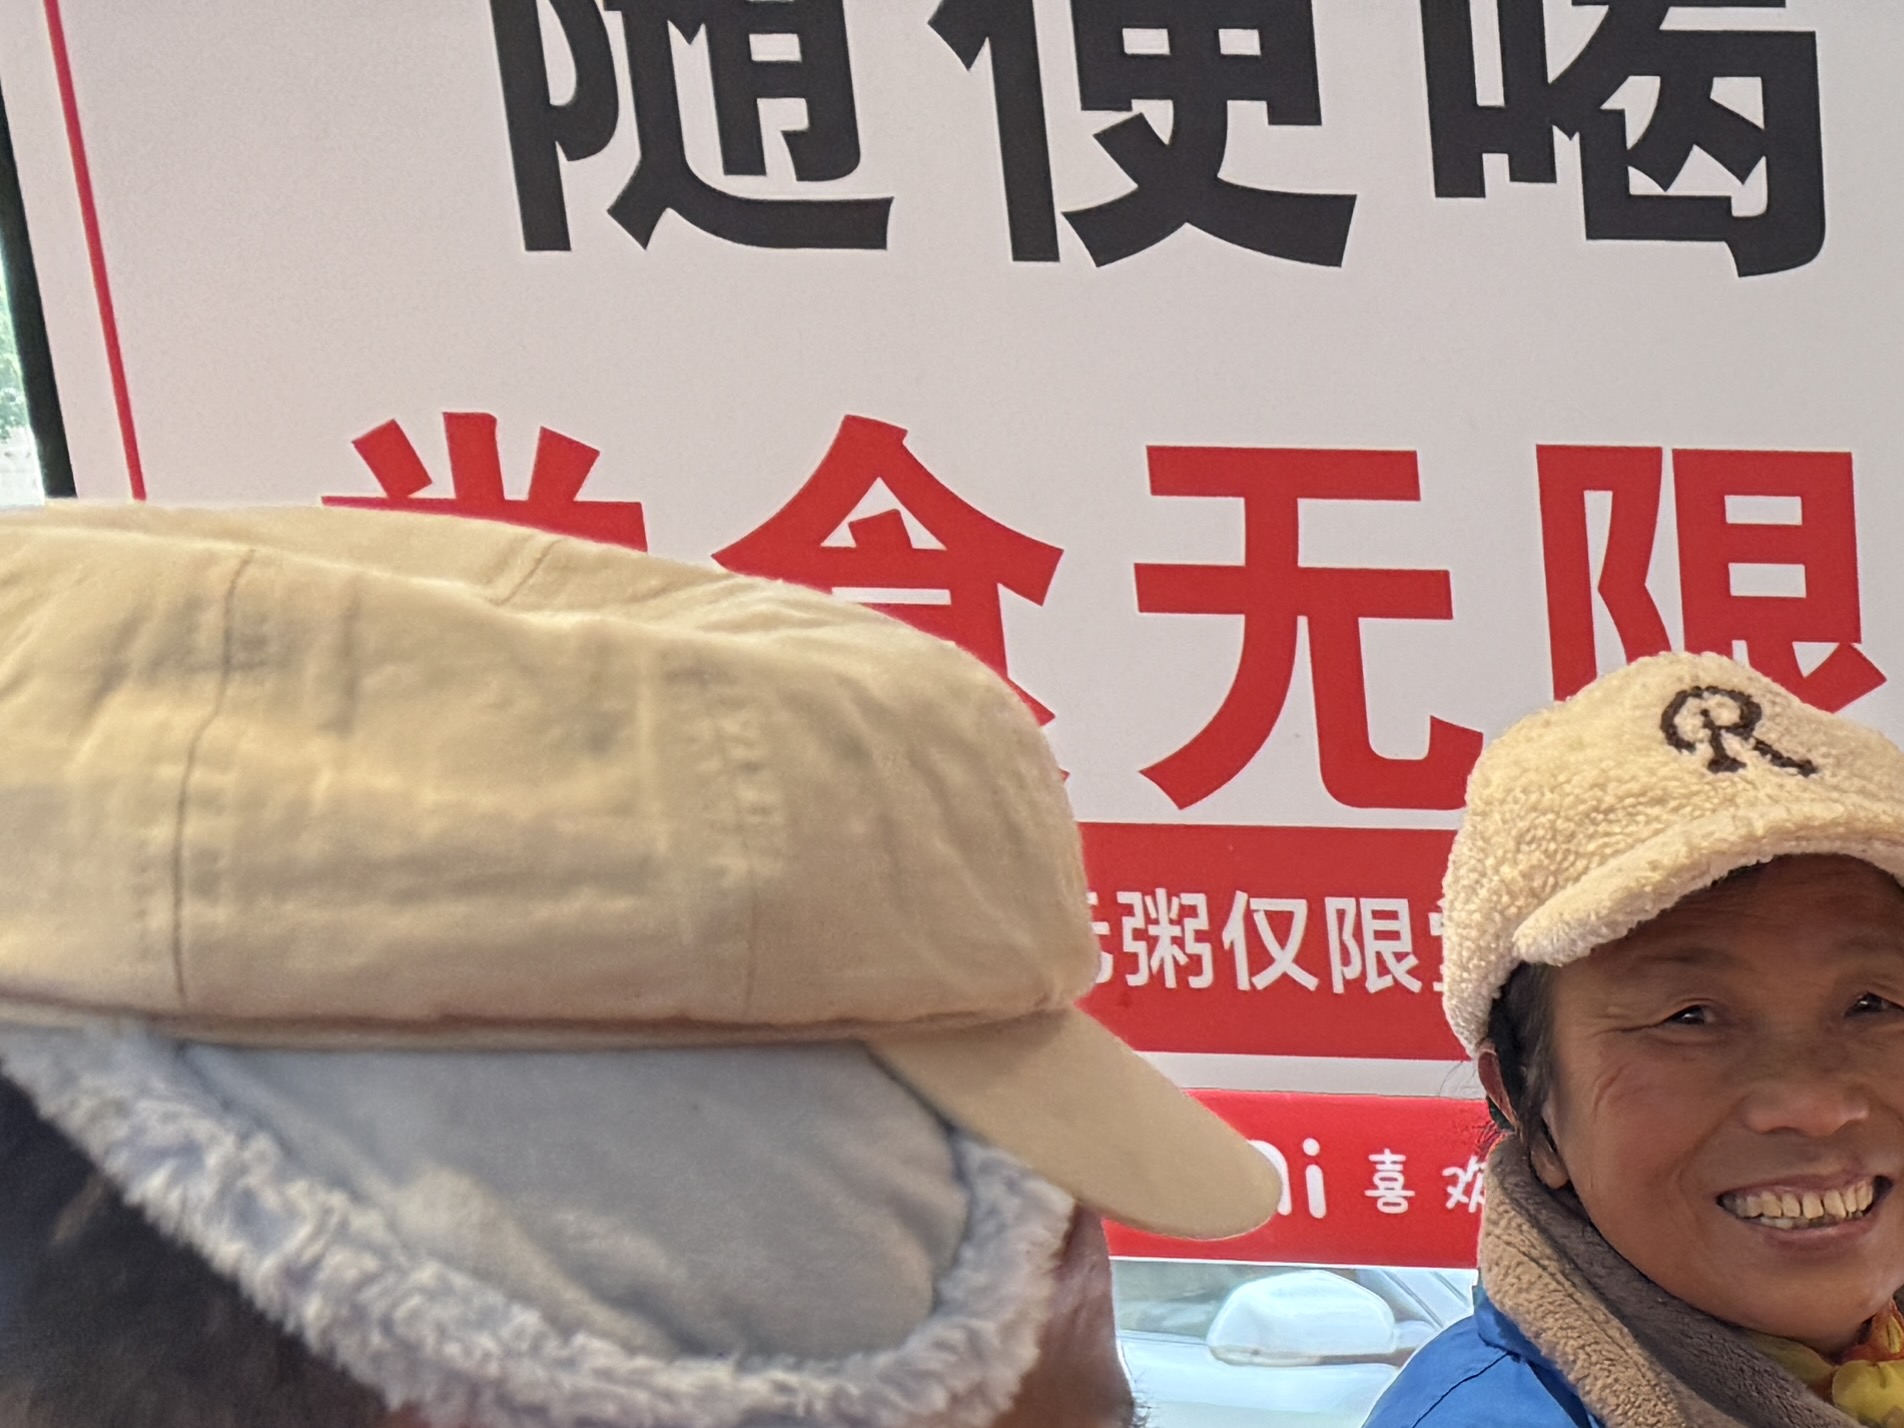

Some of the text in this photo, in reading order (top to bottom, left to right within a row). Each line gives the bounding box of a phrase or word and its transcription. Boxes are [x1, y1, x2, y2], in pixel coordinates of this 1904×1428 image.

[1659, 683, 1818, 778] R
[1092, 887, 1447, 995] 粥仅限
